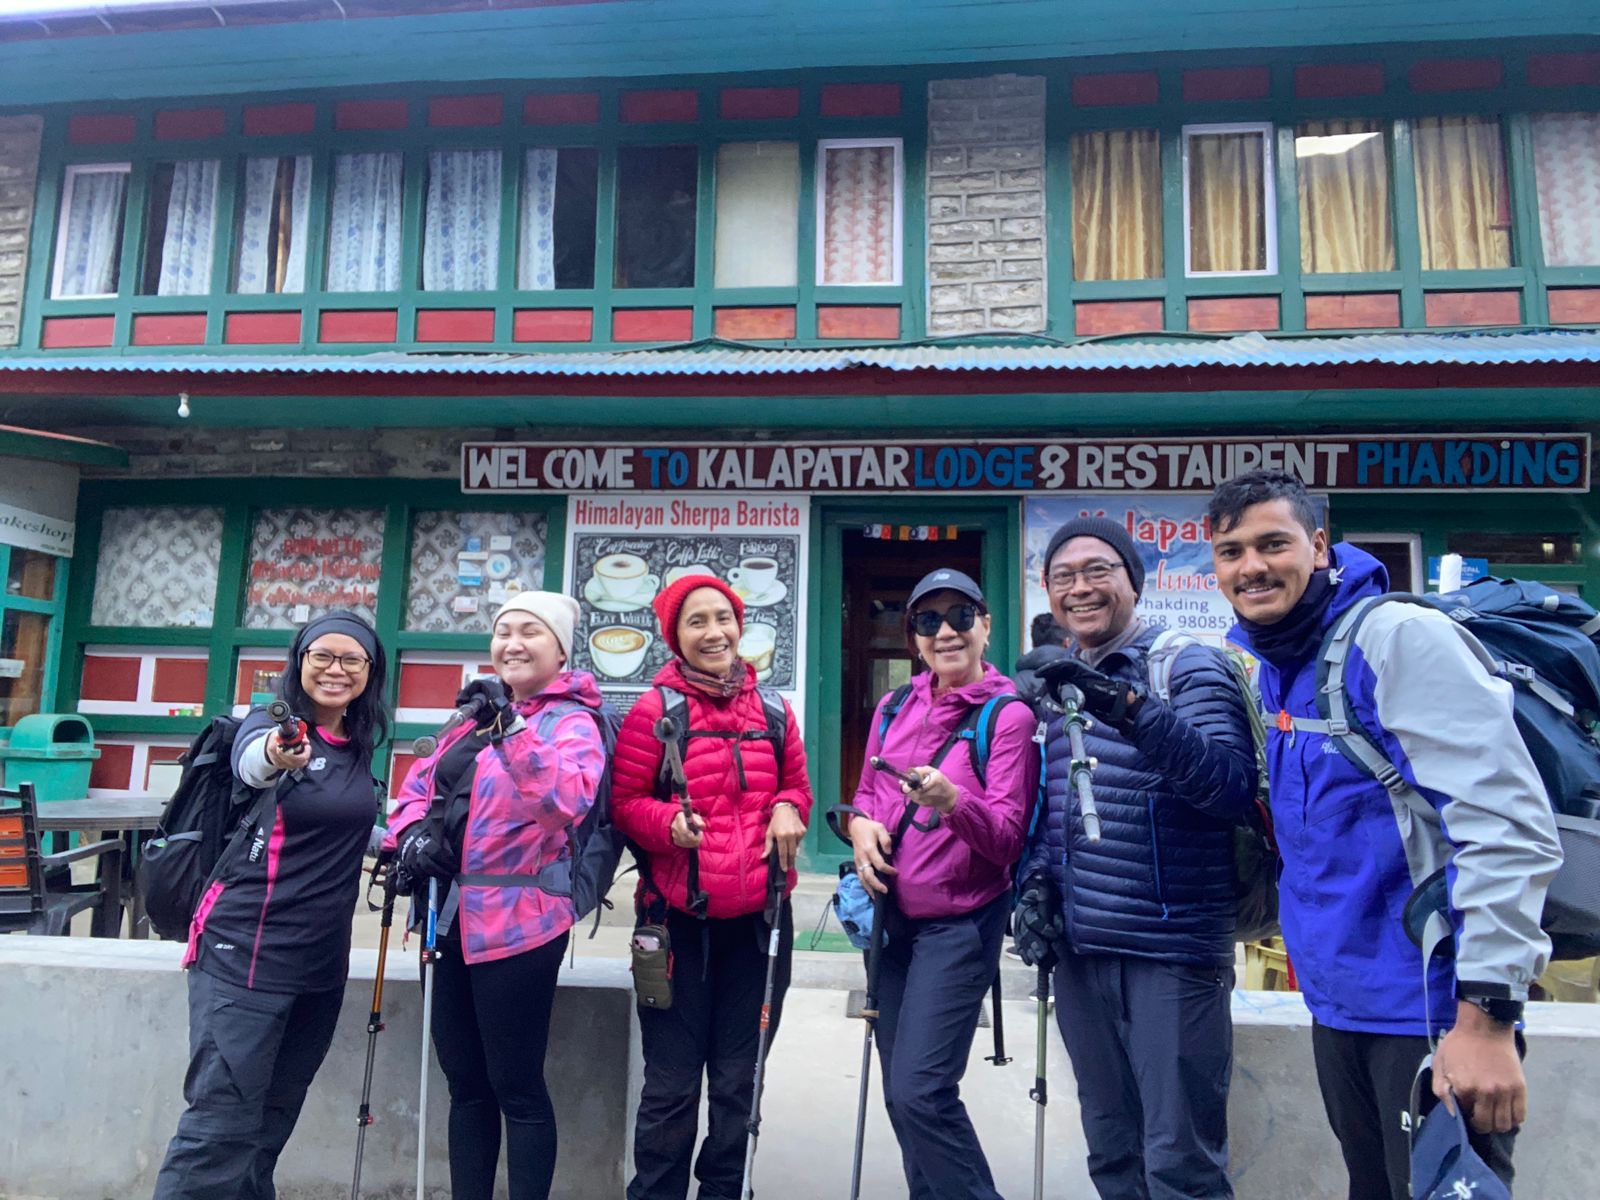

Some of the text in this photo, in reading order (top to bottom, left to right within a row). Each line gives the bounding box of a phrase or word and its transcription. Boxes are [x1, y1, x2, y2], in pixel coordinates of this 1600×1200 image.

[643, 449, 690, 487] TO
[697, 446, 910, 489] KALAPATAR
[913, 446, 1035, 489] LODGE
[0, 516, 73, 542] akeshop
[575, 499, 799, 531] Himalayan Sherpa Barista
[1156, 562, 1219, 591] lunc
[1178, 615, 1236, 629] 980851
